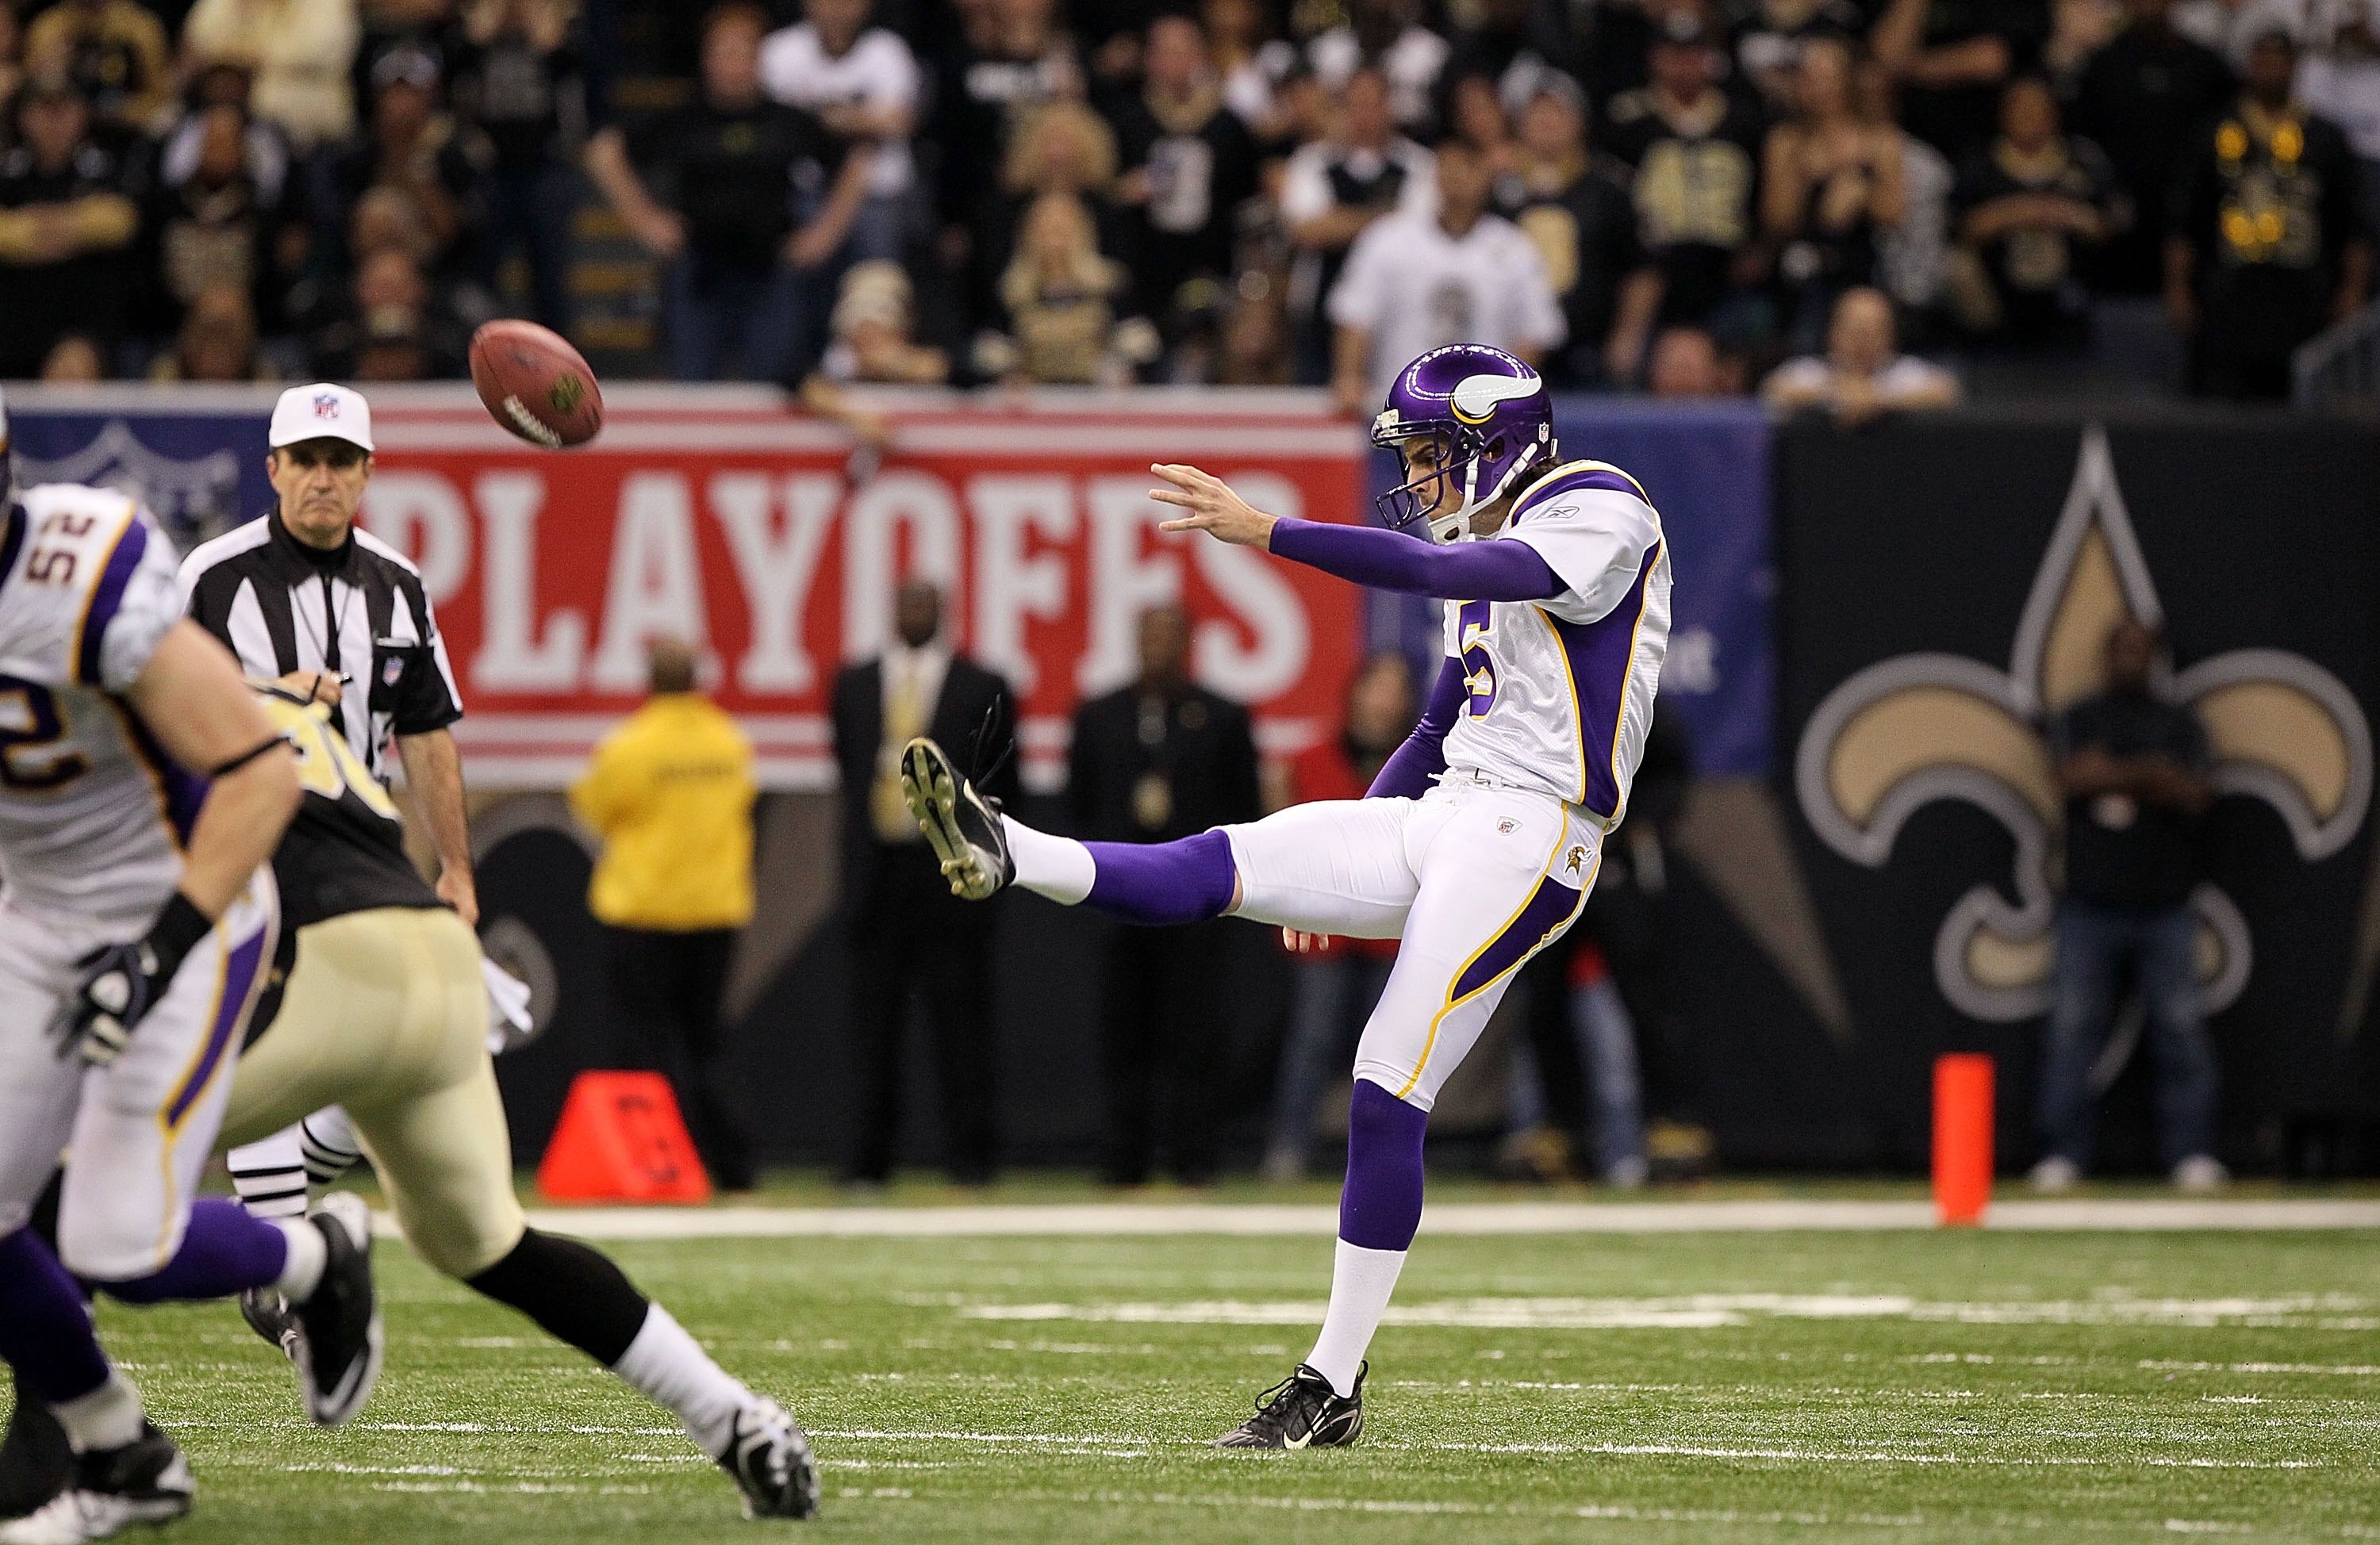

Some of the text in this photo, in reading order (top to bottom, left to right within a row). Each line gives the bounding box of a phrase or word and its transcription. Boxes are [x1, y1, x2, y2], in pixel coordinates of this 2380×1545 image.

[24, 512, 95, 585] 52
[361, 468, 1311, 703] PLAYOFFS
[1458, 600, 1497, 721] 5
